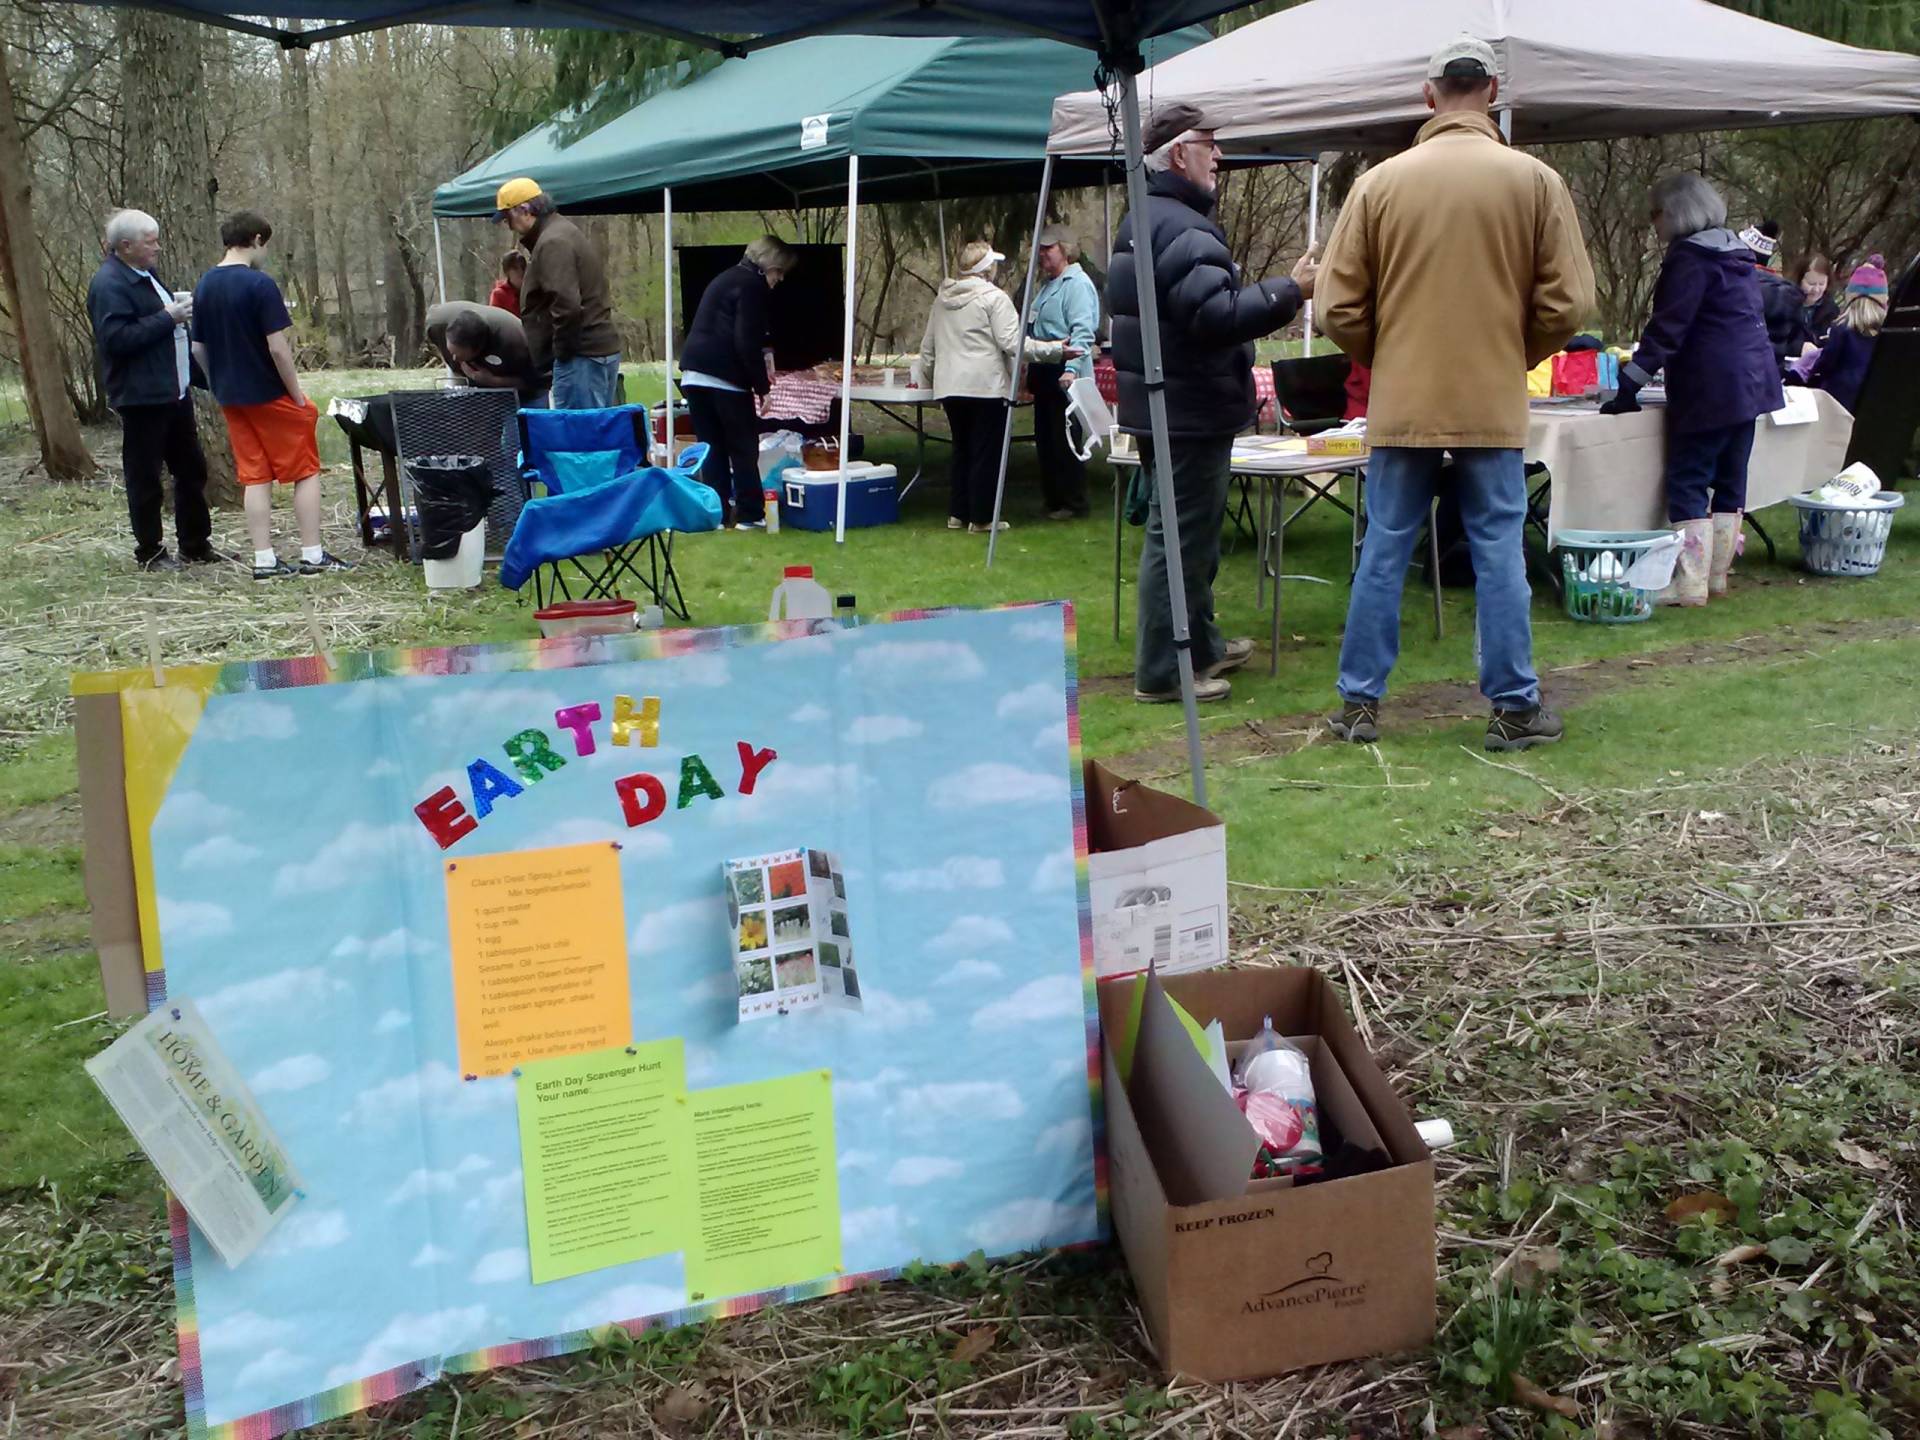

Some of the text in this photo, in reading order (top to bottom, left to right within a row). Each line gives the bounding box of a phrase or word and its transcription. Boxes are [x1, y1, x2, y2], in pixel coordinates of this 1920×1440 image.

[413, 694, 661, 851] EARTH
[615, 740, 777, 828] DAY
[536, 1060, 662, 1091] Earth Day Scavenger Hunt
[536, 1092, 560, 1103] Your
[159, 1031, 211, 1096] HOME
[206, 1095, 222, 1113] &
[220, 1113, 281, 1199] GARDEN
[1174, 1207, 1275, 1233] KEEP FROZEN
[1240, 1283, 1367, 1315] AdvancePierre
